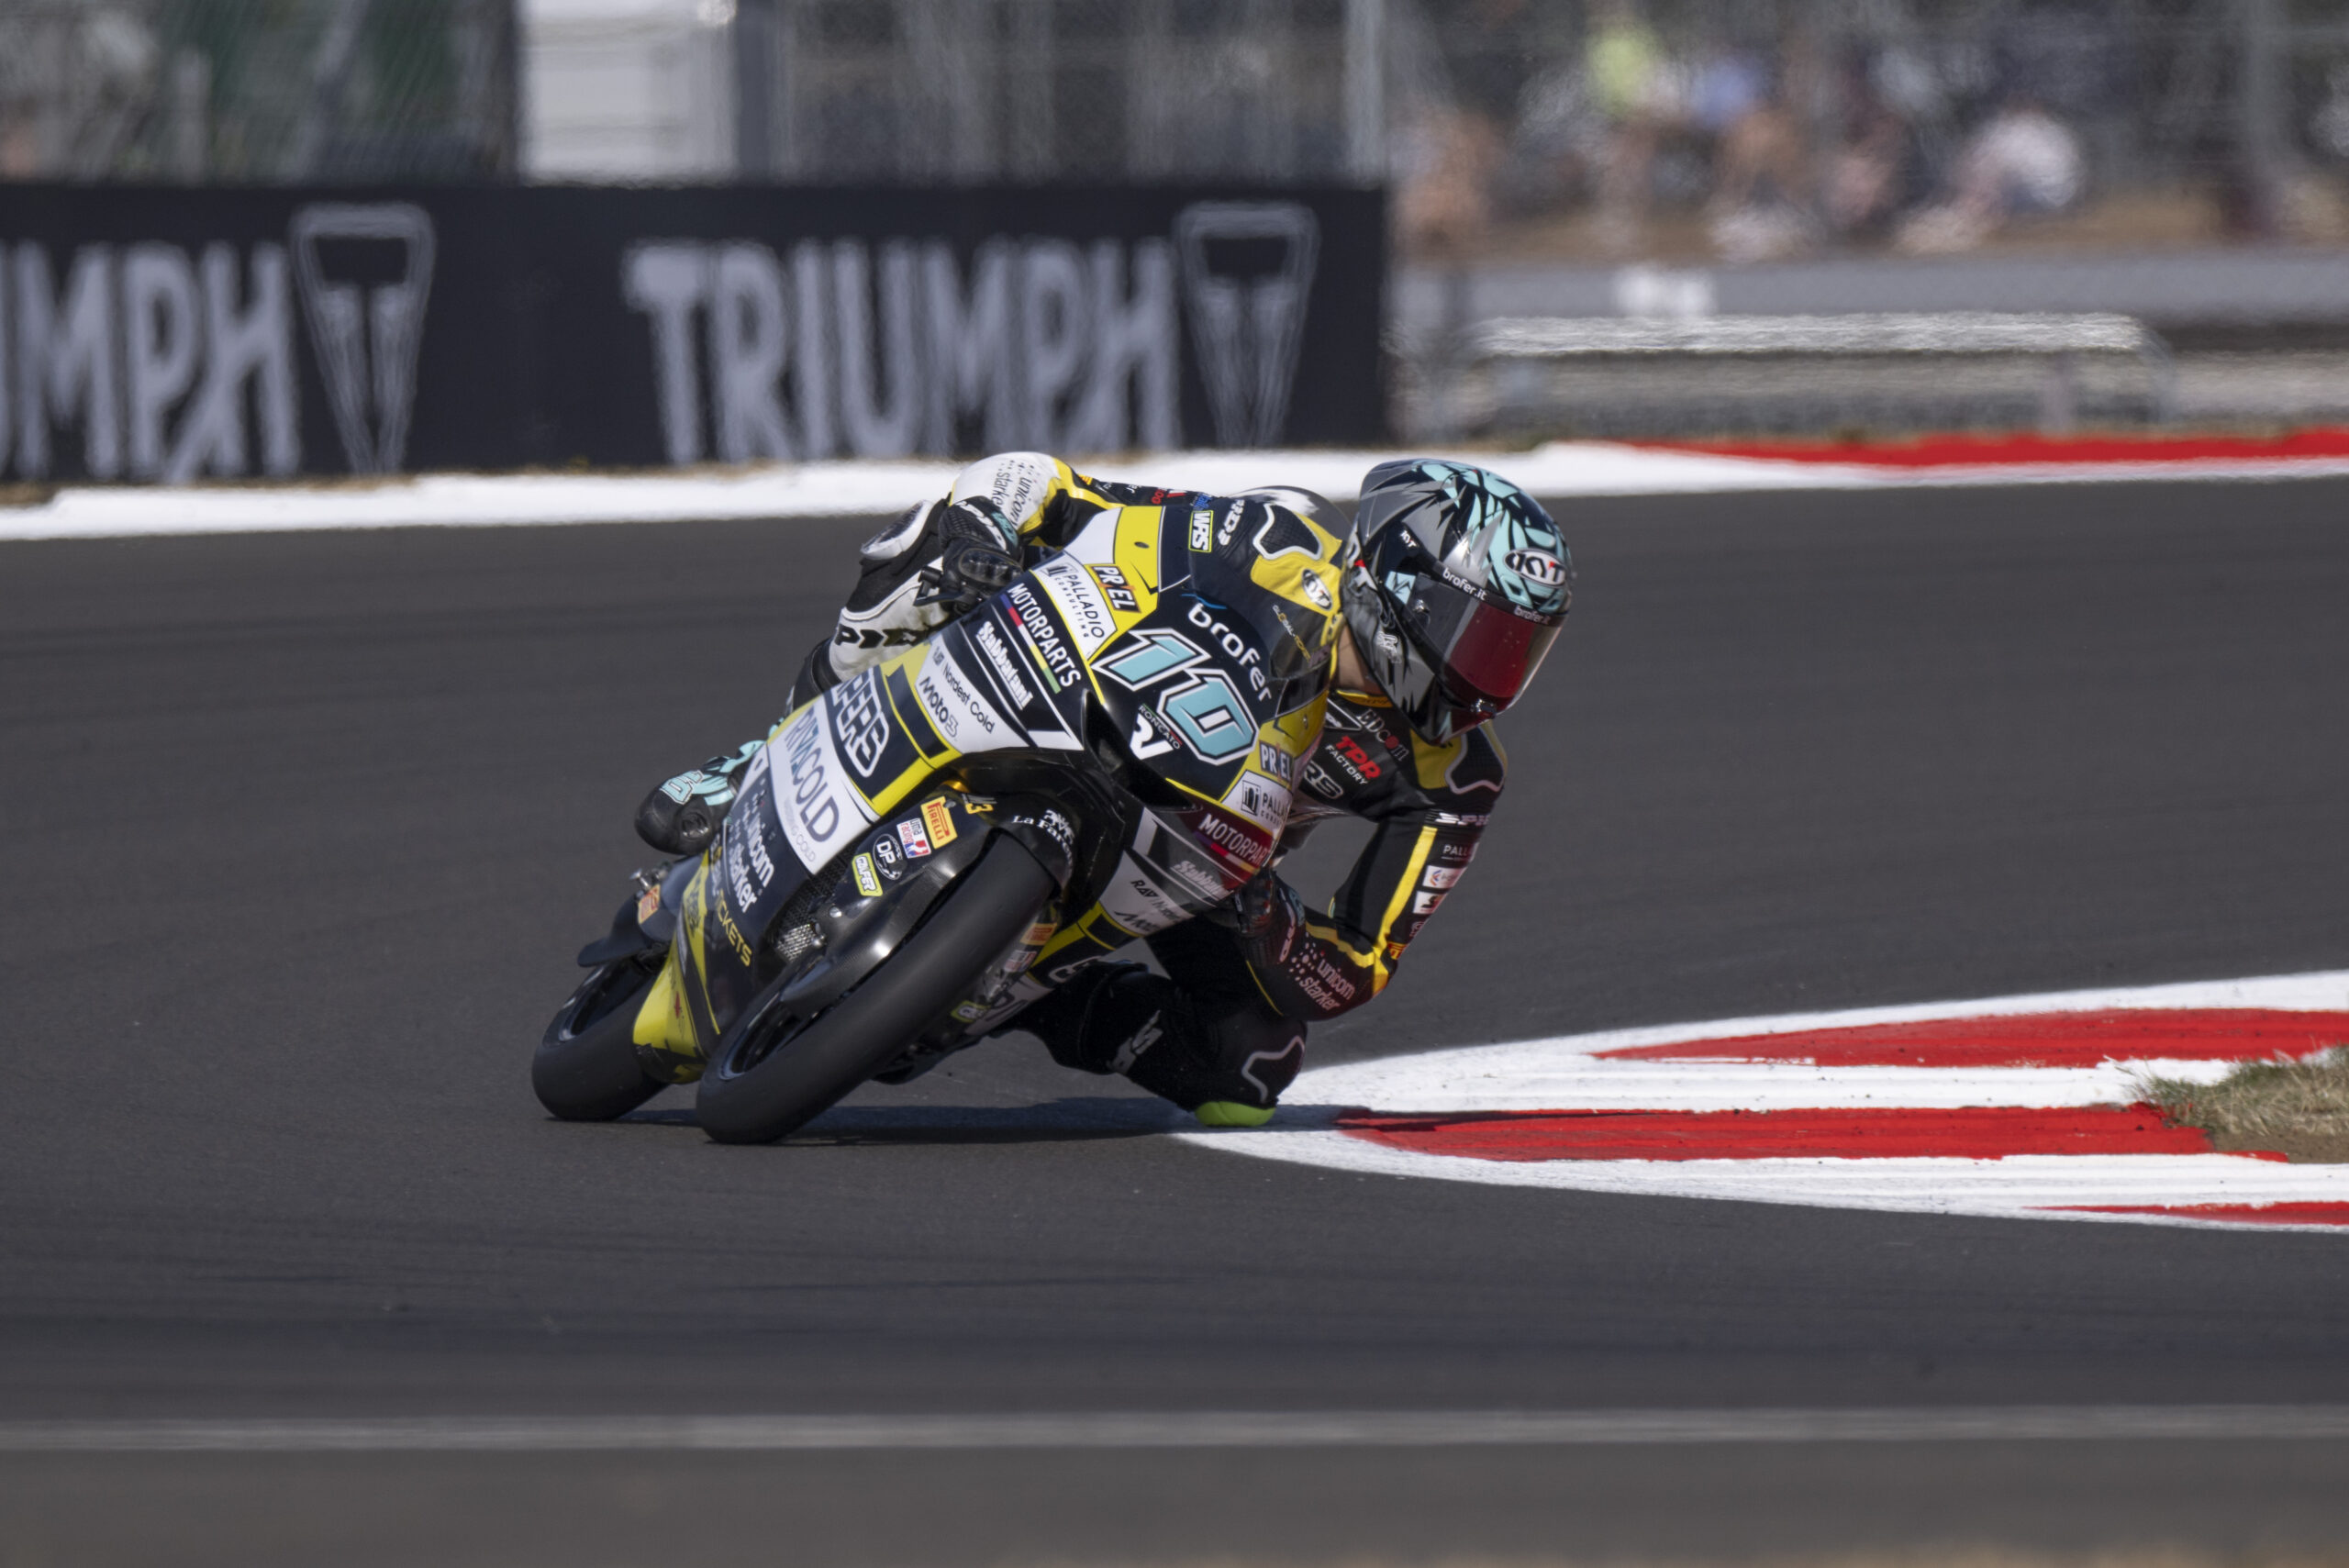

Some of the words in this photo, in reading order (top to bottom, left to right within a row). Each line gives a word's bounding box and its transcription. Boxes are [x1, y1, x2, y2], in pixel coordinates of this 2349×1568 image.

[0, 239, 300, 484] MPH
[625, 236, 1181, 462] TRIUMPH
[991, 472, 1011, 506] starke
[1192, 512, 1212, 551] WRS
[1442, 568, 1488, 602] brofer.it
[1517, 552, 1565, 581] KYT
[1063, 573, 1105, 639] PALLADIO
[1008, 583, 1082, 687] MOTORPARTS
[1188, 603, 1272, 702] brofer
[942, 664, 971, 706] Nordest
[970, 701, 996, 734] Cold
[1090, 628, 1259, 765] 10
[1138, 705, 1181, 750] RONCATO
[1325, 744, 1368, 786] FACTORY
[1336, 736, 1382, 780] TPR
[900, 822, 916, 845] racing
[927, 802, 951, 840] PIRELLI
[877, 840, 896, 865] DP
[1299, 975, 1341, 1011] starker
[1317, 959, 1356, 1000] unicom
